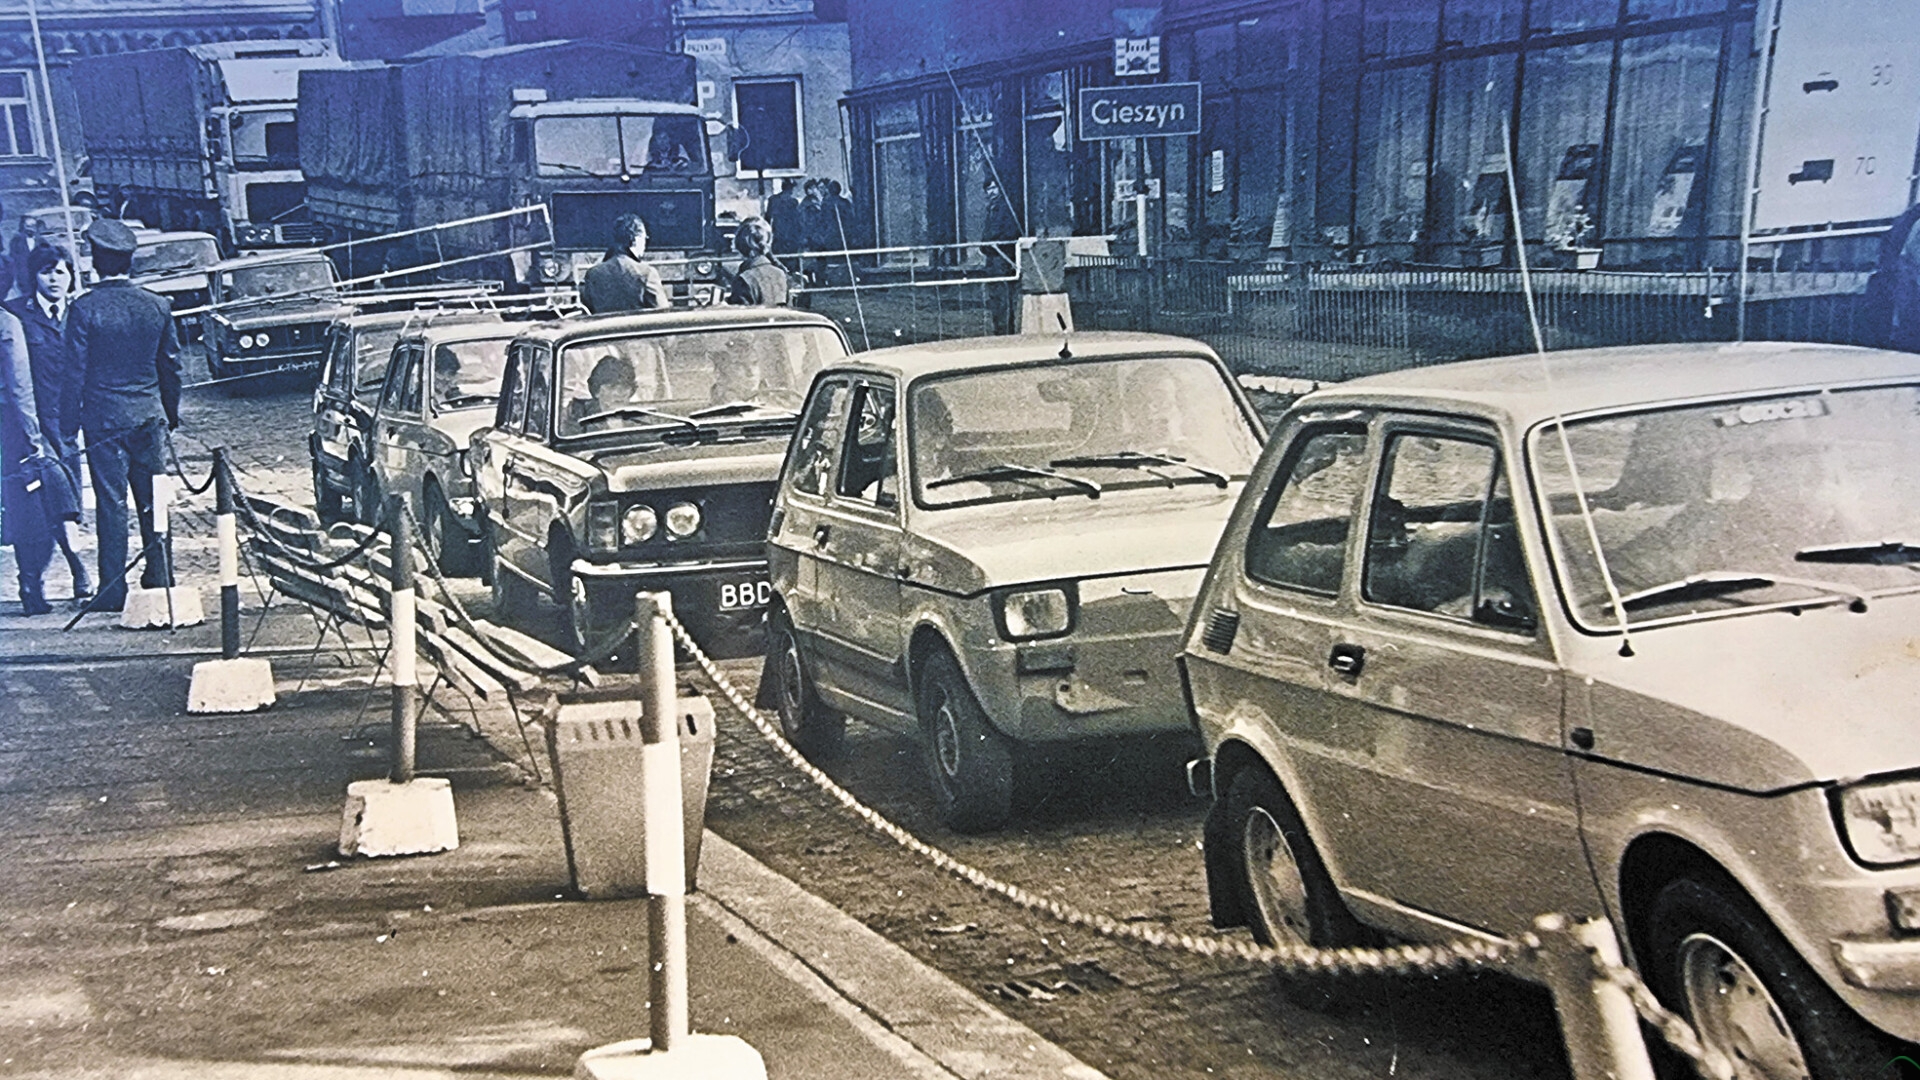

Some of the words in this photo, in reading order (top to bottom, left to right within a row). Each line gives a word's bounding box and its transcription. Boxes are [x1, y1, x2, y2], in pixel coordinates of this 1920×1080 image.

[697, 81, 715, 109] P
[1091, 99, 1184, 128] Cieszyn
[1855, 156, 1876, 175] 70
[721, 581, 771, 607] BBD
